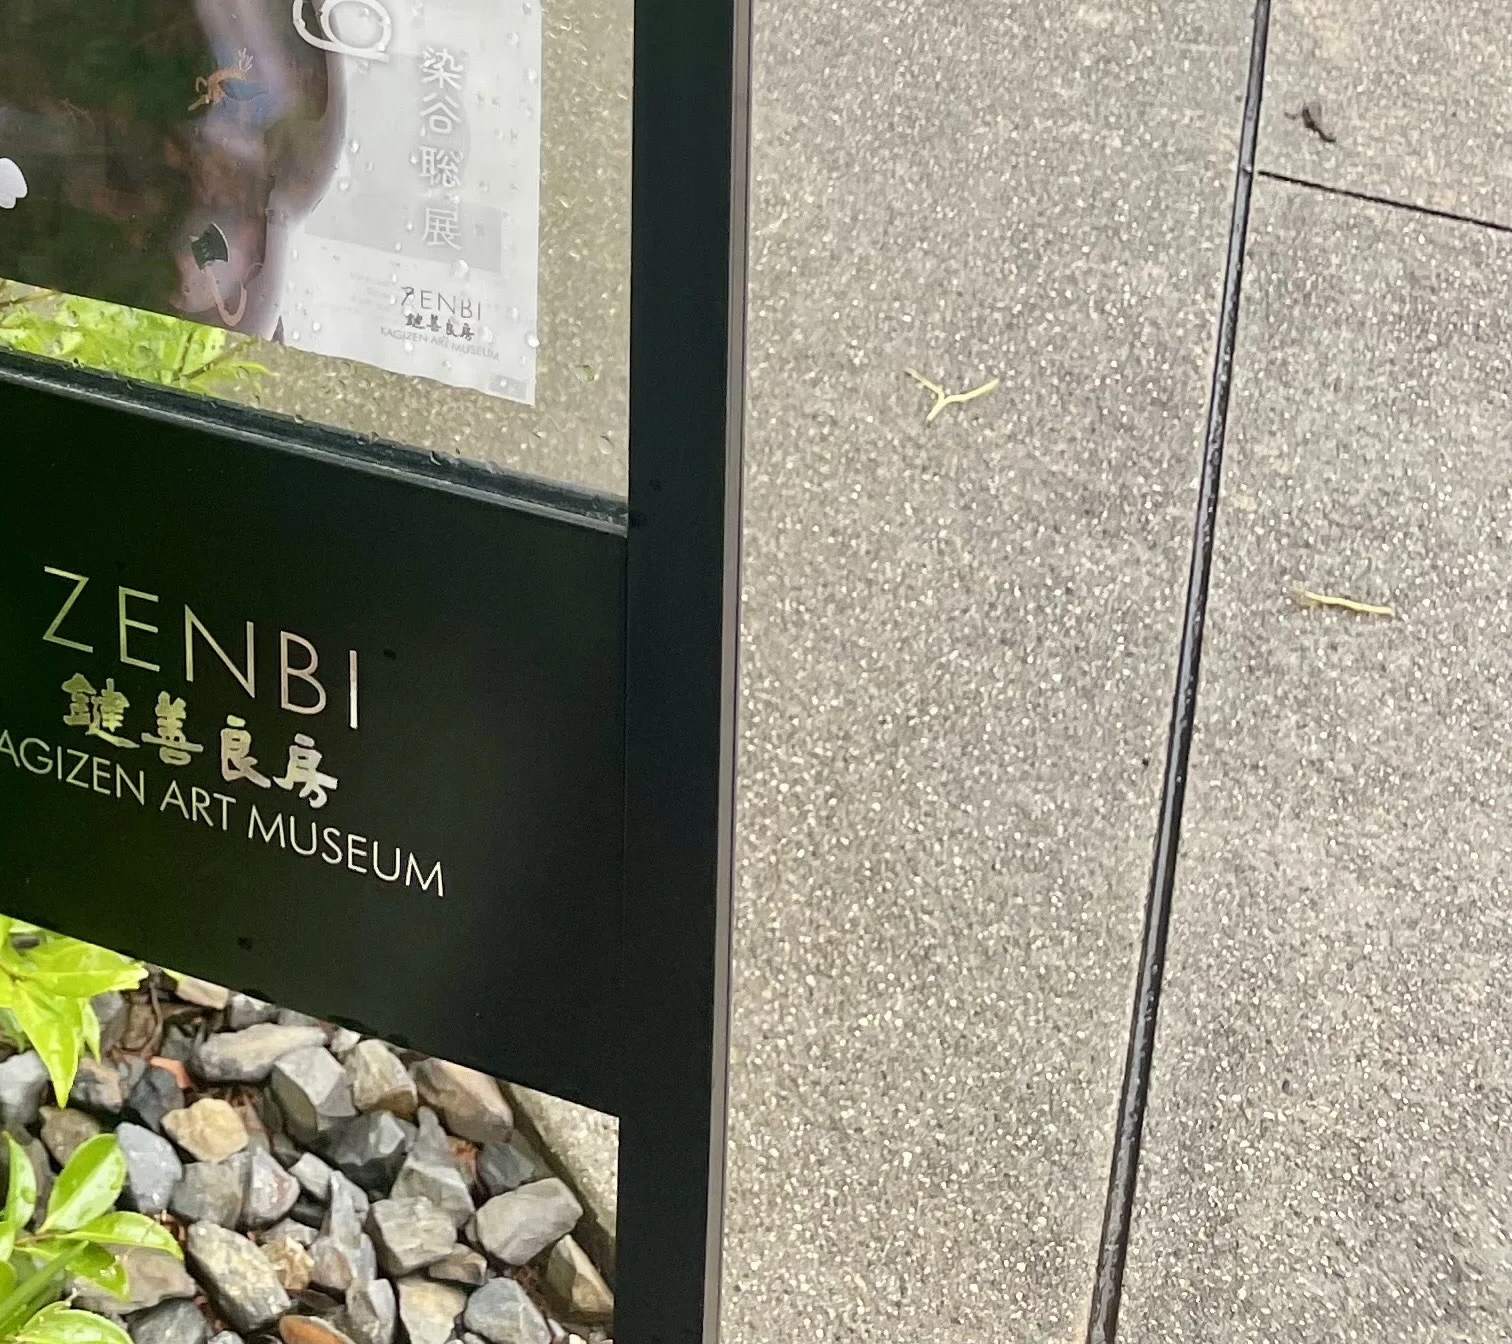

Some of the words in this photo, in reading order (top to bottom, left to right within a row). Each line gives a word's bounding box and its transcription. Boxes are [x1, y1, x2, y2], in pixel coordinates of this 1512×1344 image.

[380, 325, 428, 346] KAGIZEN
[451, 341, 500, 362] MUSEUM
[42, 566, 358, 729] ZENBI
[61, 673, 338, 808] 鍵善良房
[160, 780, 236, 831] ART
[248, 805, 444, 897] MUSEUM
